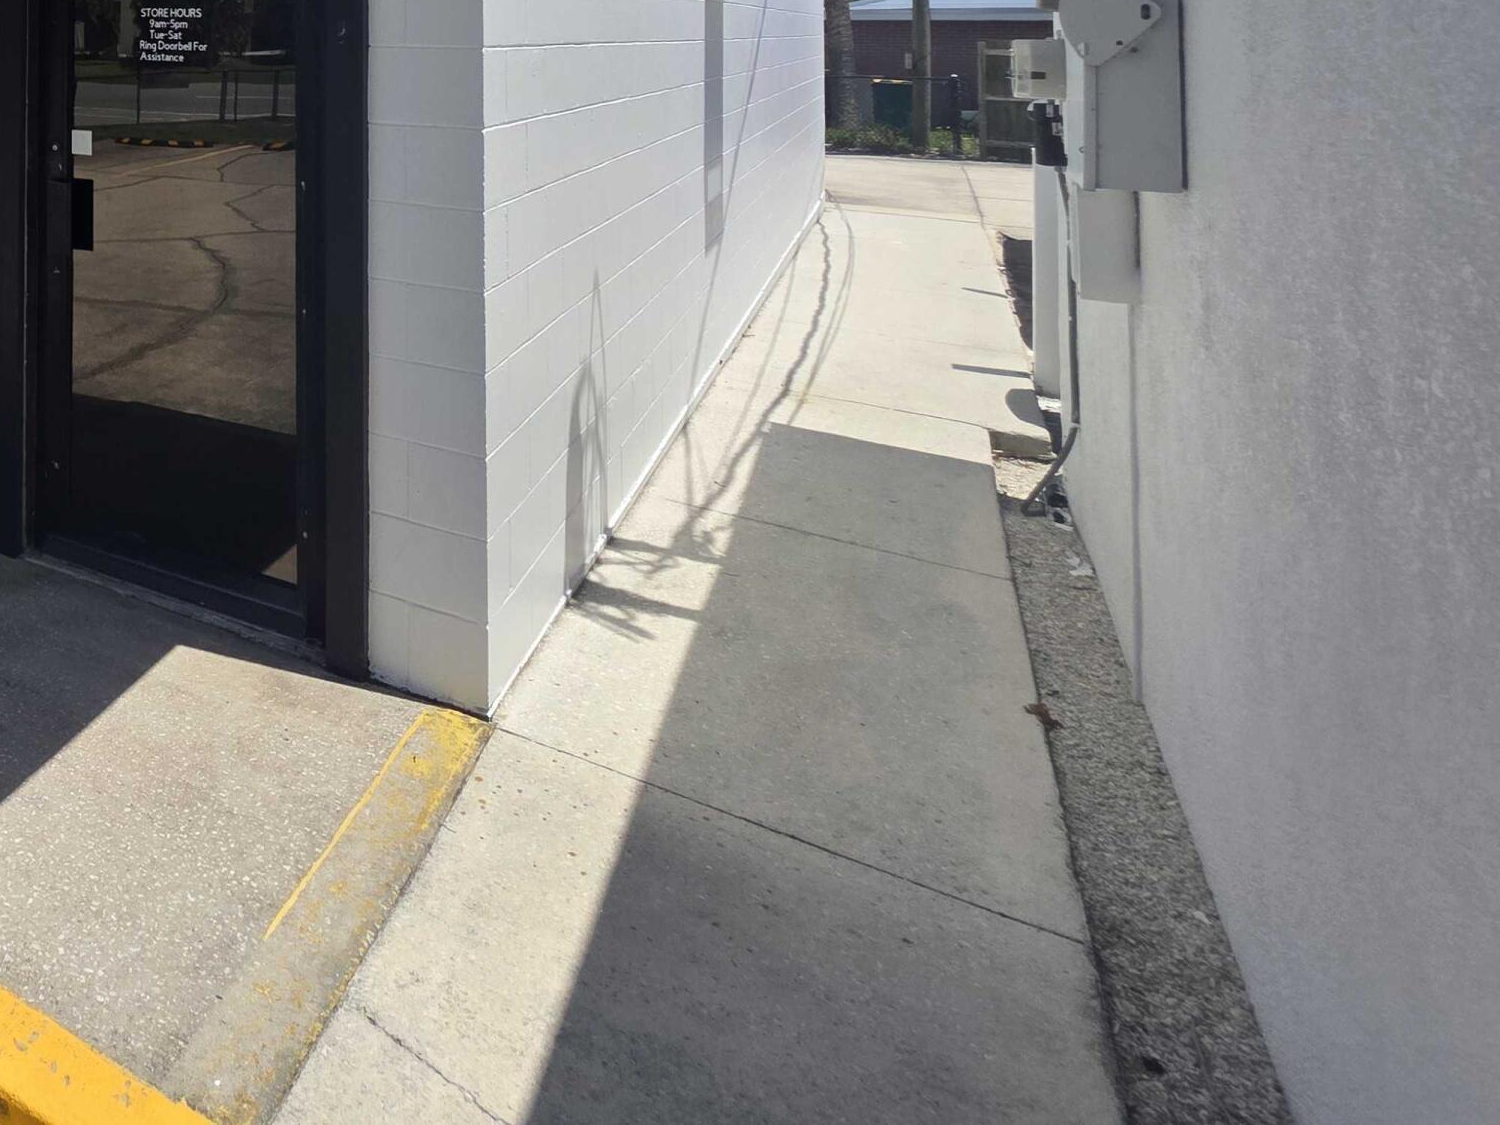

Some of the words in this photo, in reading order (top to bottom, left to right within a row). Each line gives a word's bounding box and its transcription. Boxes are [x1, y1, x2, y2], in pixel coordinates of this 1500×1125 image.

[140, 8, 169, 17] STORE
[170, 8, 202, 18] HOURS
[149, 19, 188, 30] 9am-5pm
[149, 29, 182, 40] Tue-Sat
[140, 40, 157, 52] Ring
[158, 40, 192, 51] Doorbell
[193, 41, 208, 51] For
[140, 51, 184, 62] Assistance
